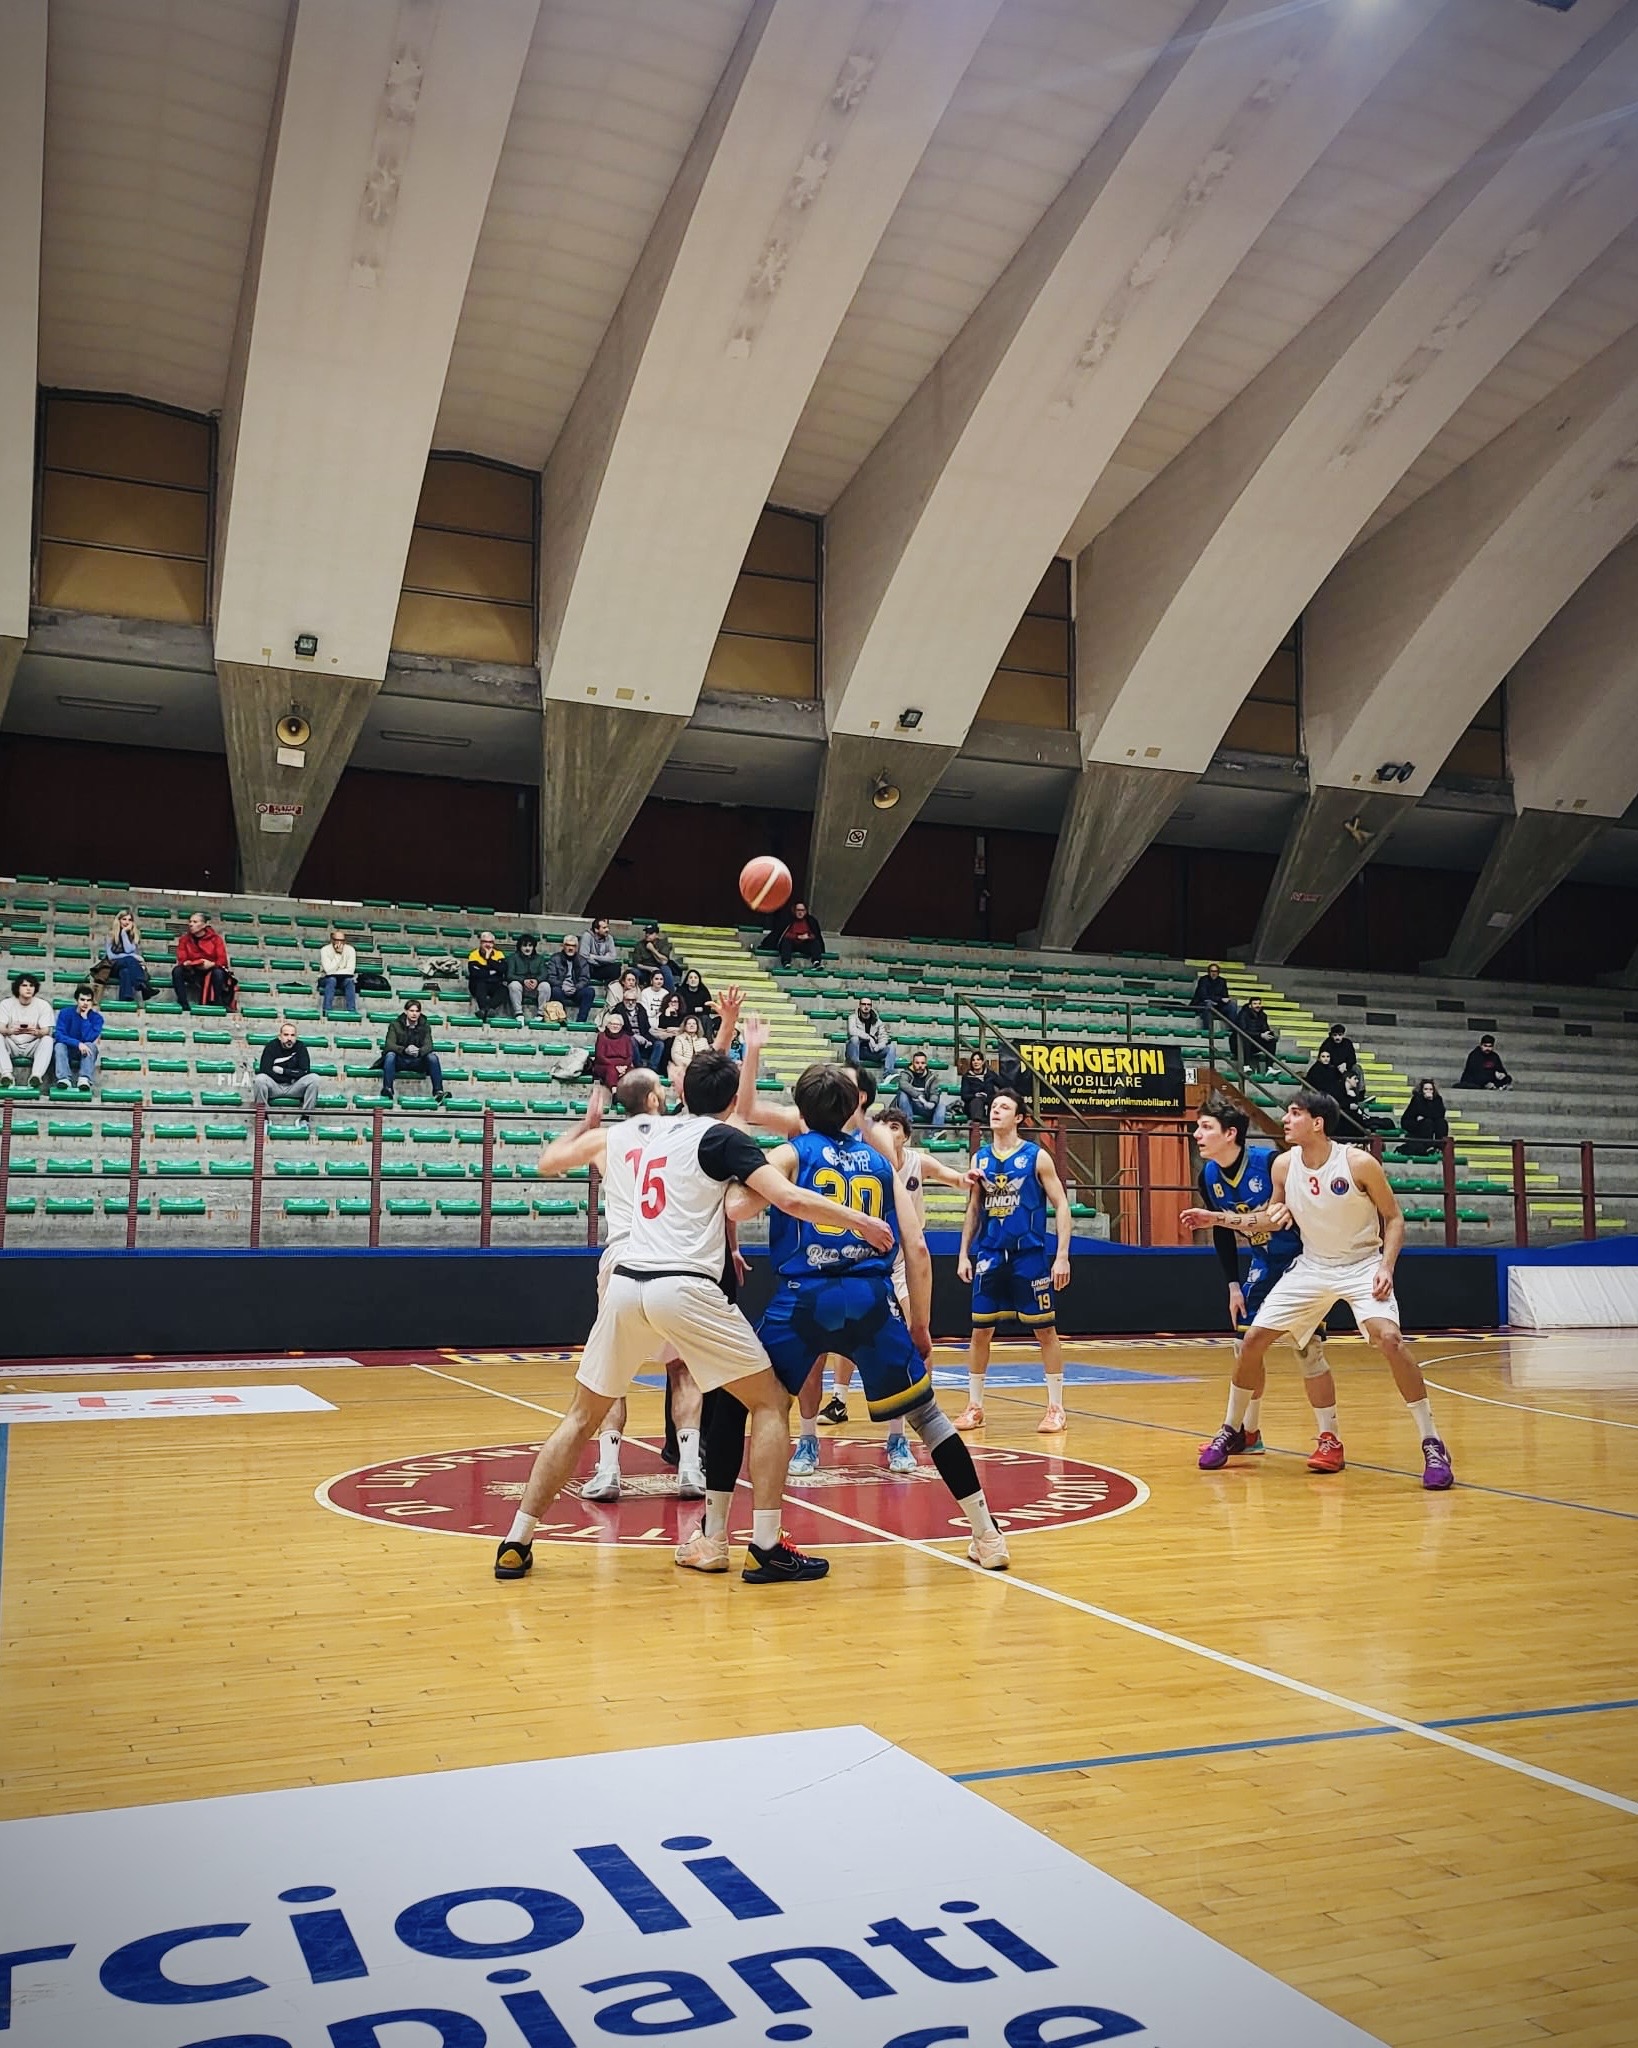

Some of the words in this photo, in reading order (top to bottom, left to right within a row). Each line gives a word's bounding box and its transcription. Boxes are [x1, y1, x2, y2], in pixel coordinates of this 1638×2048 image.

[1019, 1044, 1165, 1076] FRANGERINI
[217, 1071, 252, 1088] FILA
[1044, 1074, 1142, 1088] IMMOBILIARE
[1308, 1176, 1320, 1196] 3
[813, 1167, 884, 1240] 30
[984, 1194, 1021, 1209] UNION
[1037, 1292, 1051, 1311] 19
